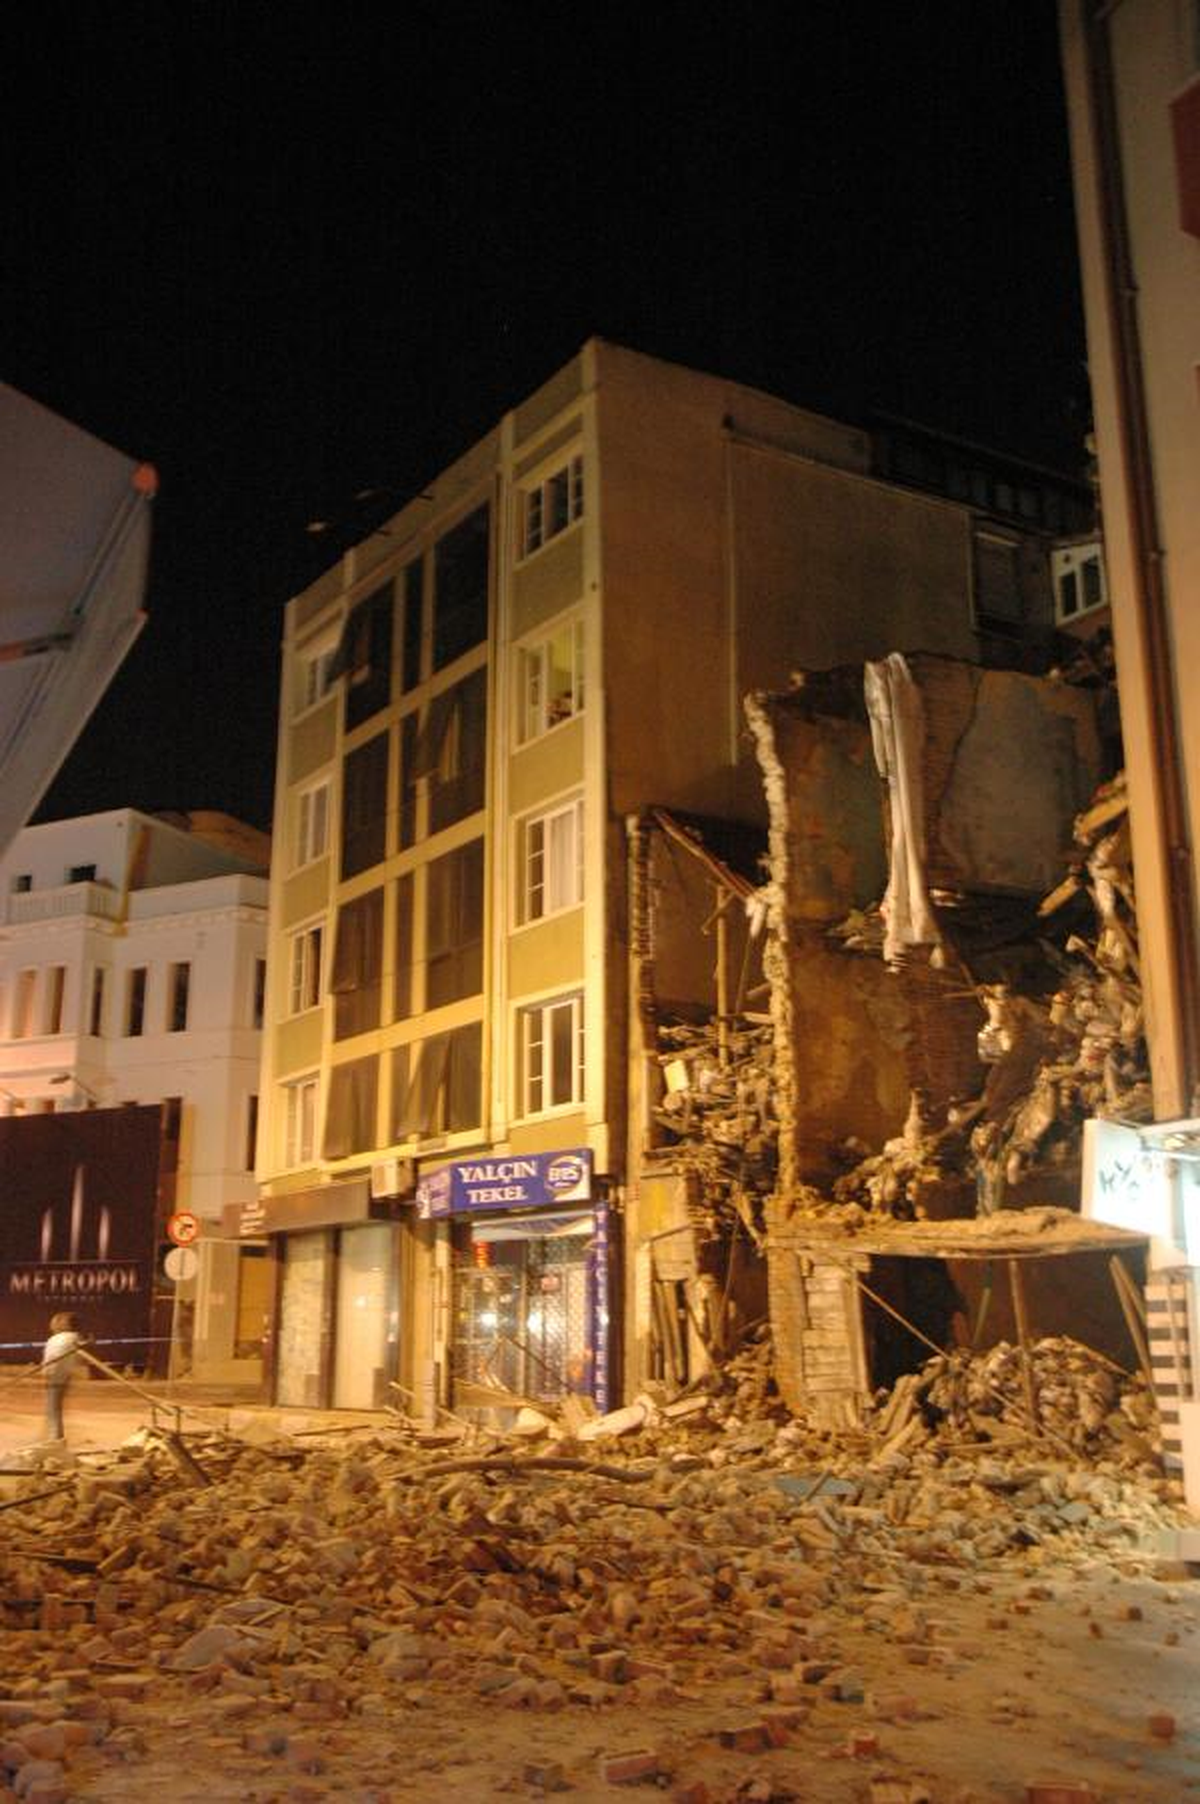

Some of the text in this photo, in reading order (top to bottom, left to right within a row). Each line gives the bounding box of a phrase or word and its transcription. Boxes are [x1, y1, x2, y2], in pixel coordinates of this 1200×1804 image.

[458, 1161, 538, 1184] YALÇIN
[466, 1186, 529, 1204] TEKEL
[10, 1268, 140, 1294] METROPOL
